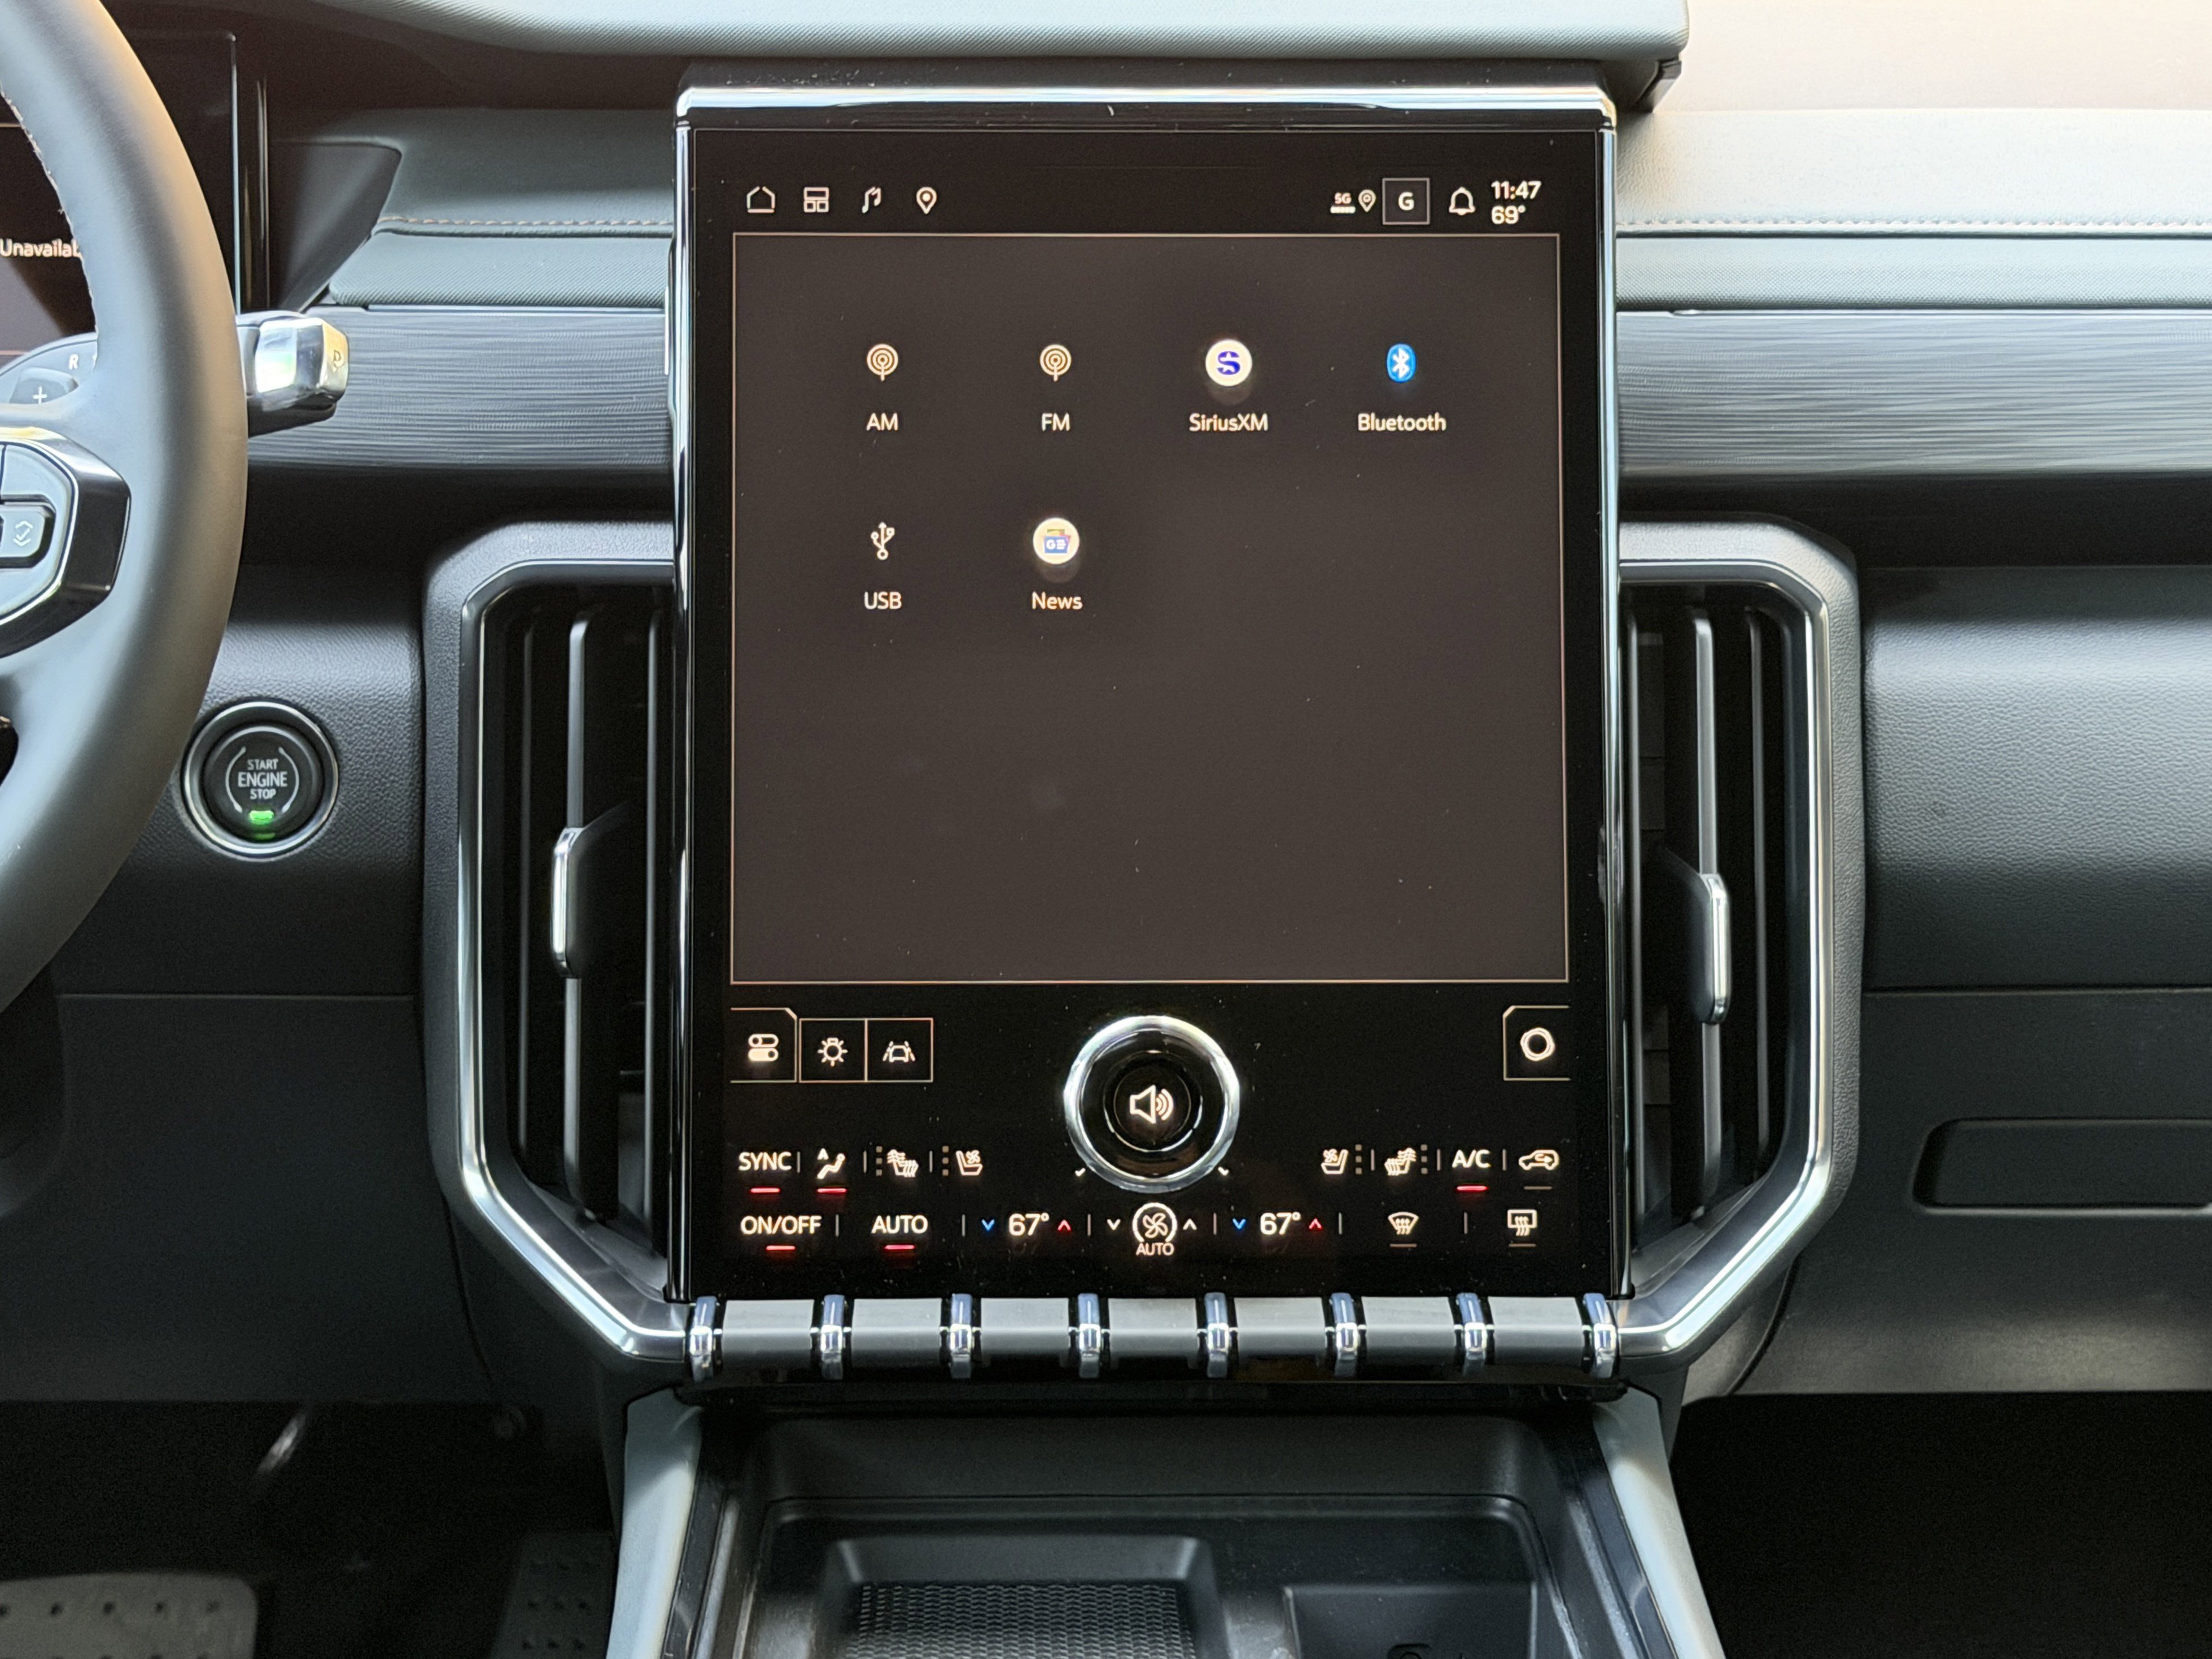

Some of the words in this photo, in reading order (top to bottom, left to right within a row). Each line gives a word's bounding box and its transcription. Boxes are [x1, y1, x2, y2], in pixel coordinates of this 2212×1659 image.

[1334, 192, 1352, 205] 5G
[1490, 180, 1542, 200] 11:47
[1398, 191, 1415, 211] G
[1491, 204, 1526, 225] 69°
[68, 353, 79, 370] R
[866, 412, 899, 431] AM
[1041, 413, 1070, 431] FM
[1188, 412, 1269, 431] SiriusXM
[1358, 412, 1446, 431] Bluetooth
[864, 591, 902, 610] USB
[1031, 591, 1083, 610] News
[247, 758, 279, 770] START
[238, 771, 287, 788] ENGINE
[250, 788, 277, 800] STOP
[738, 1151, 793, 1171] SYNC
[1452, 1149, 1491, 1169] A/C
[740, 1215, 823, 1235] ON/OFF
[871, 1215, 928, 1234] AUTO
[1008, 1212, 1050, 1237] 67°
[1260, 1212, 1301, 1235] 67°
[1135, 1242, 1175, 1256] AUTO
